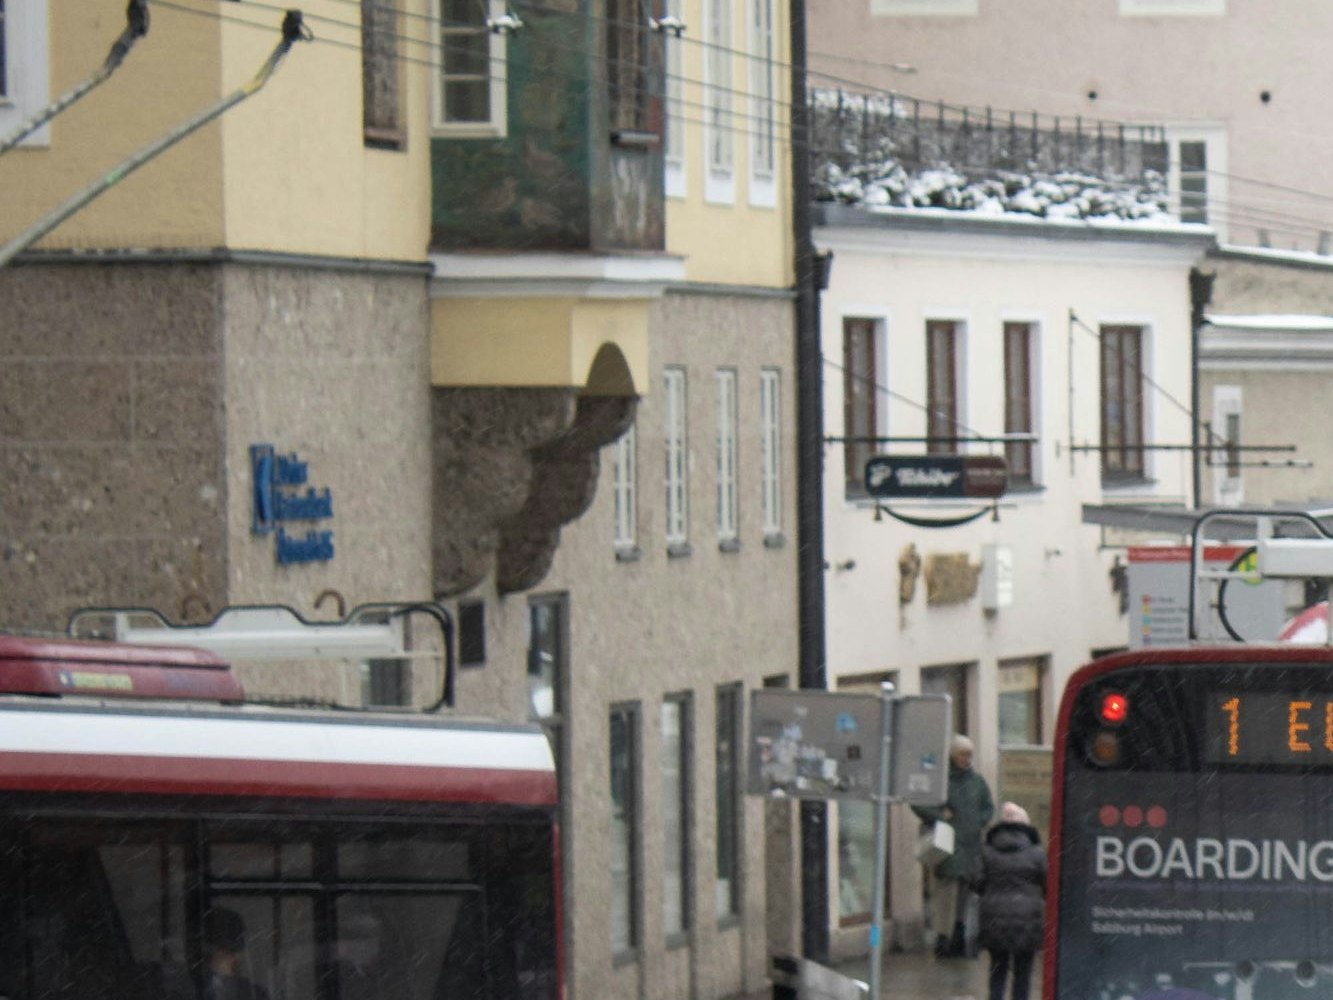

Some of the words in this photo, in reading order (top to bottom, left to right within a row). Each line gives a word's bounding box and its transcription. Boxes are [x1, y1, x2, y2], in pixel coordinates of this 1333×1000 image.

[1221, 697, 1240, 756] 1
[1091, 922, 1142, 936] Salzburg
[1143, 923, 1183, 936] Airport
